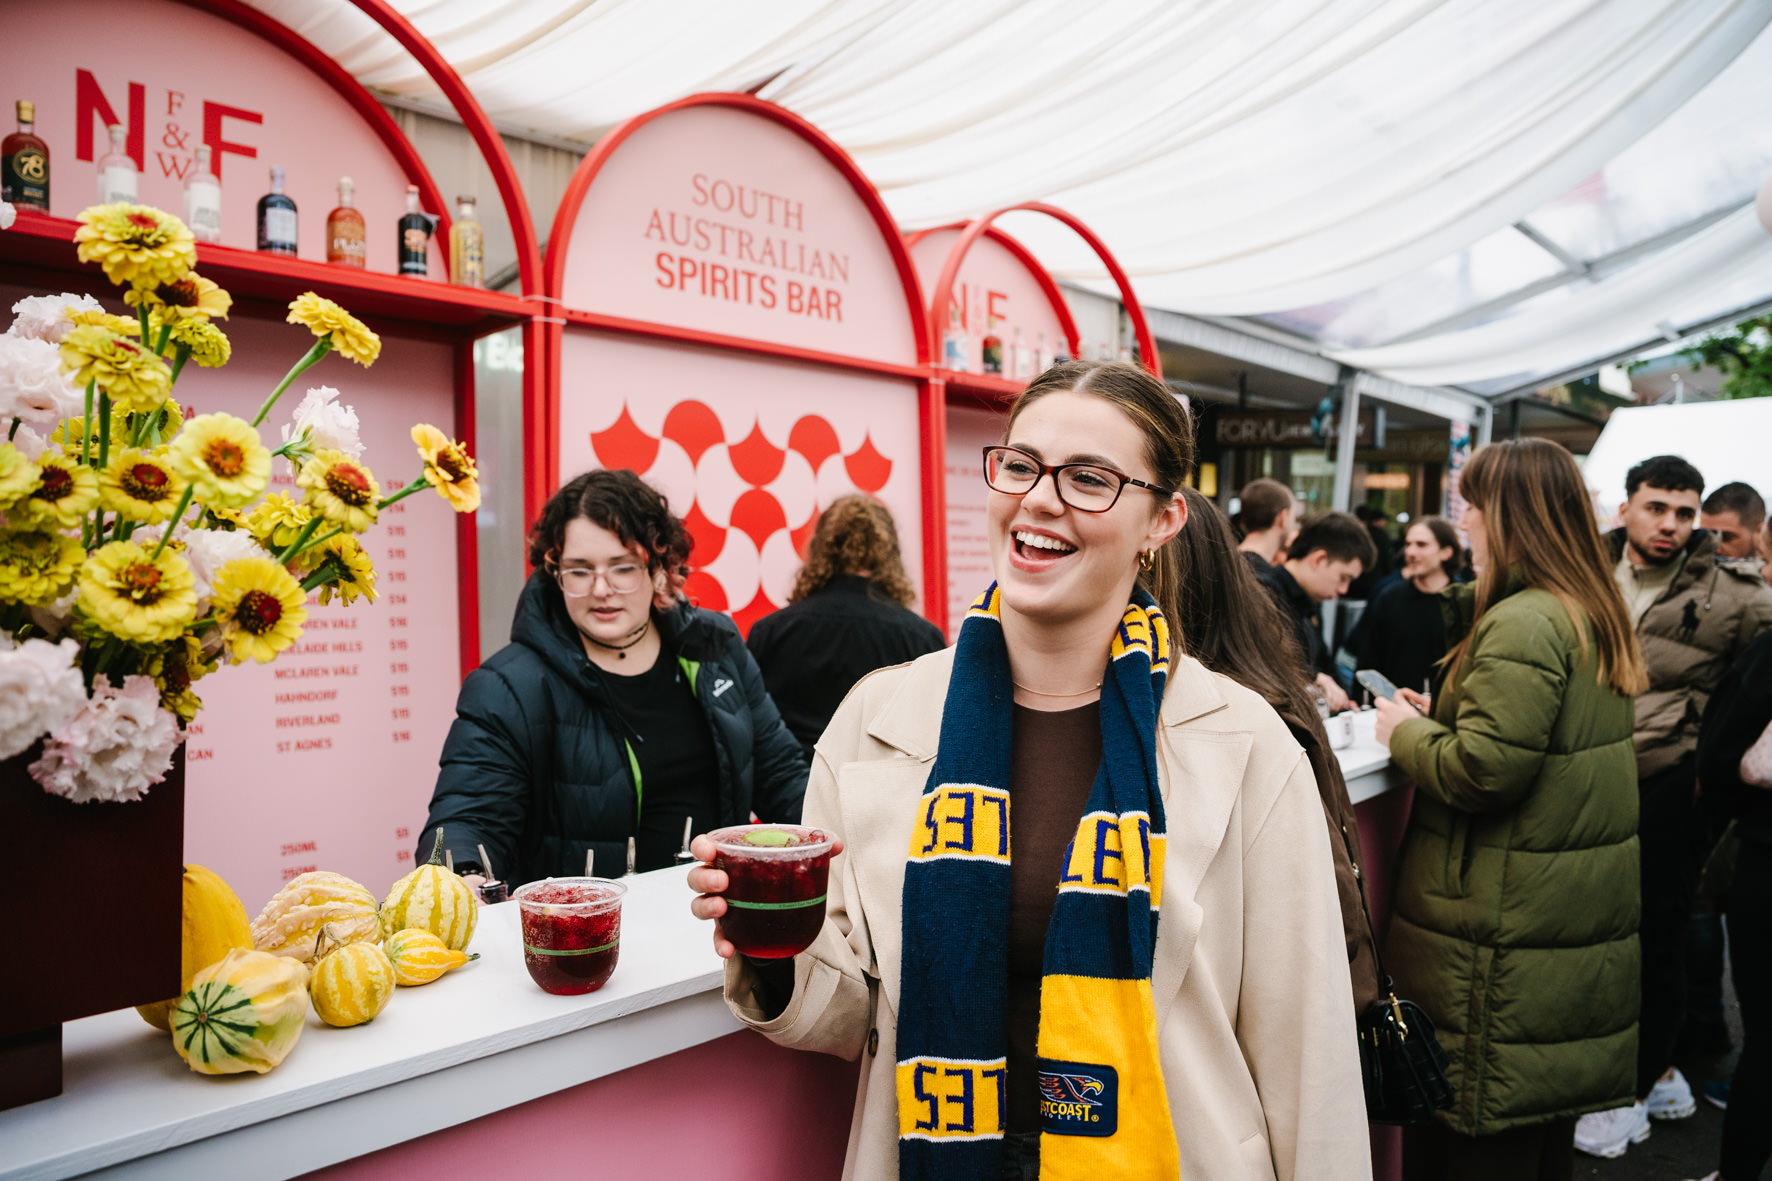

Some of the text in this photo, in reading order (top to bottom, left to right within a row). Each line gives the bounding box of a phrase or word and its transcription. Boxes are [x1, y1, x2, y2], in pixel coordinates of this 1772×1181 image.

[75, 67, 146, 174] N
[166, 89, 186, 117] F
[162, 121, 191, 151] &
[202, 99, 264, 187] F
[155, 151, 193, 181] W
[691, 173, 804, 232] SOUTH
[643, 208, 850, 284] AUSTRALIAN
[655, 252, 843, 323] SPIRITS BAR
[276, 713, 341, 728] RIVERLAND
